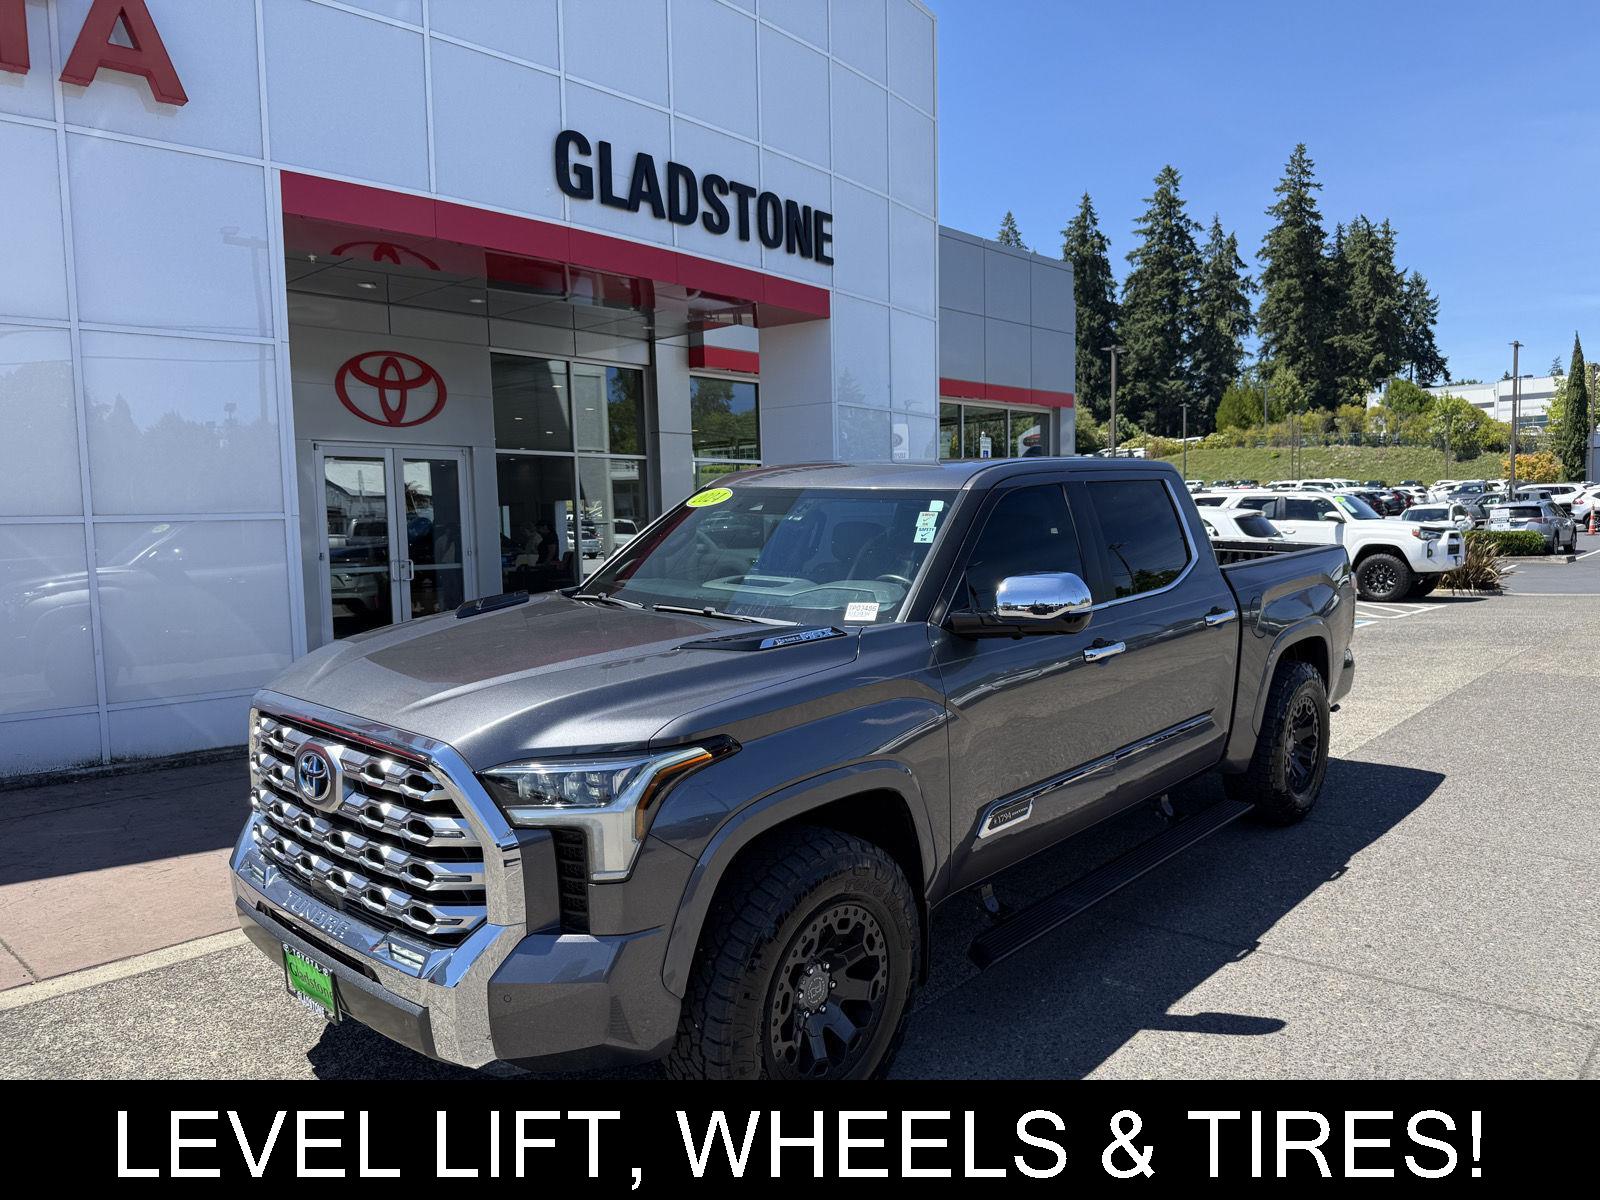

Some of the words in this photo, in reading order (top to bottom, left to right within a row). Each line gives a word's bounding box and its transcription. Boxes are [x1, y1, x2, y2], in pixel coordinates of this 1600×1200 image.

[555, 129, 835, 265] GLADSTONE
[281, 889, 350, 939] TUNDRA
[291, 947, 321, 971] TOYOTA
